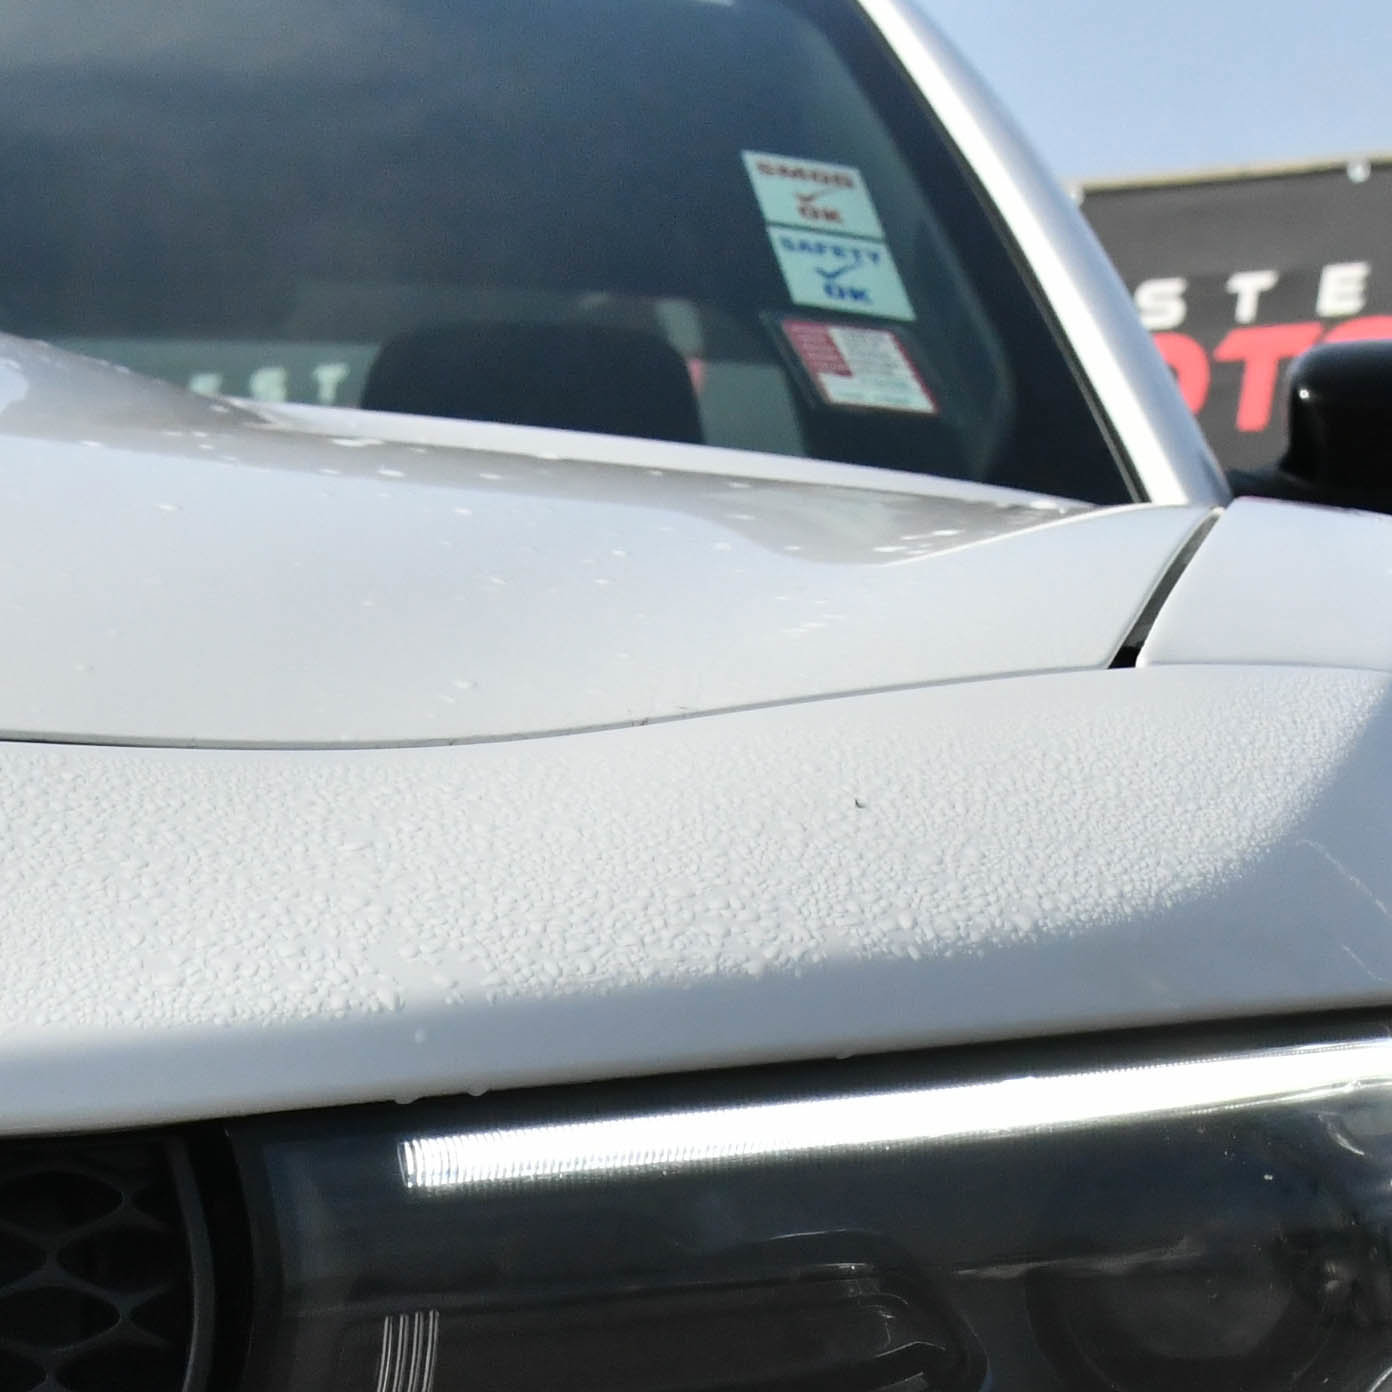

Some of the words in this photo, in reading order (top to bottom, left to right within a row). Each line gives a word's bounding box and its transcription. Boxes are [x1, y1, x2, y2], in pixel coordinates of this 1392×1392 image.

[797, 204, 843, 224] OK
[779, 235, 881, 264] SAFETY
[823, 282, 873, 305] OK
